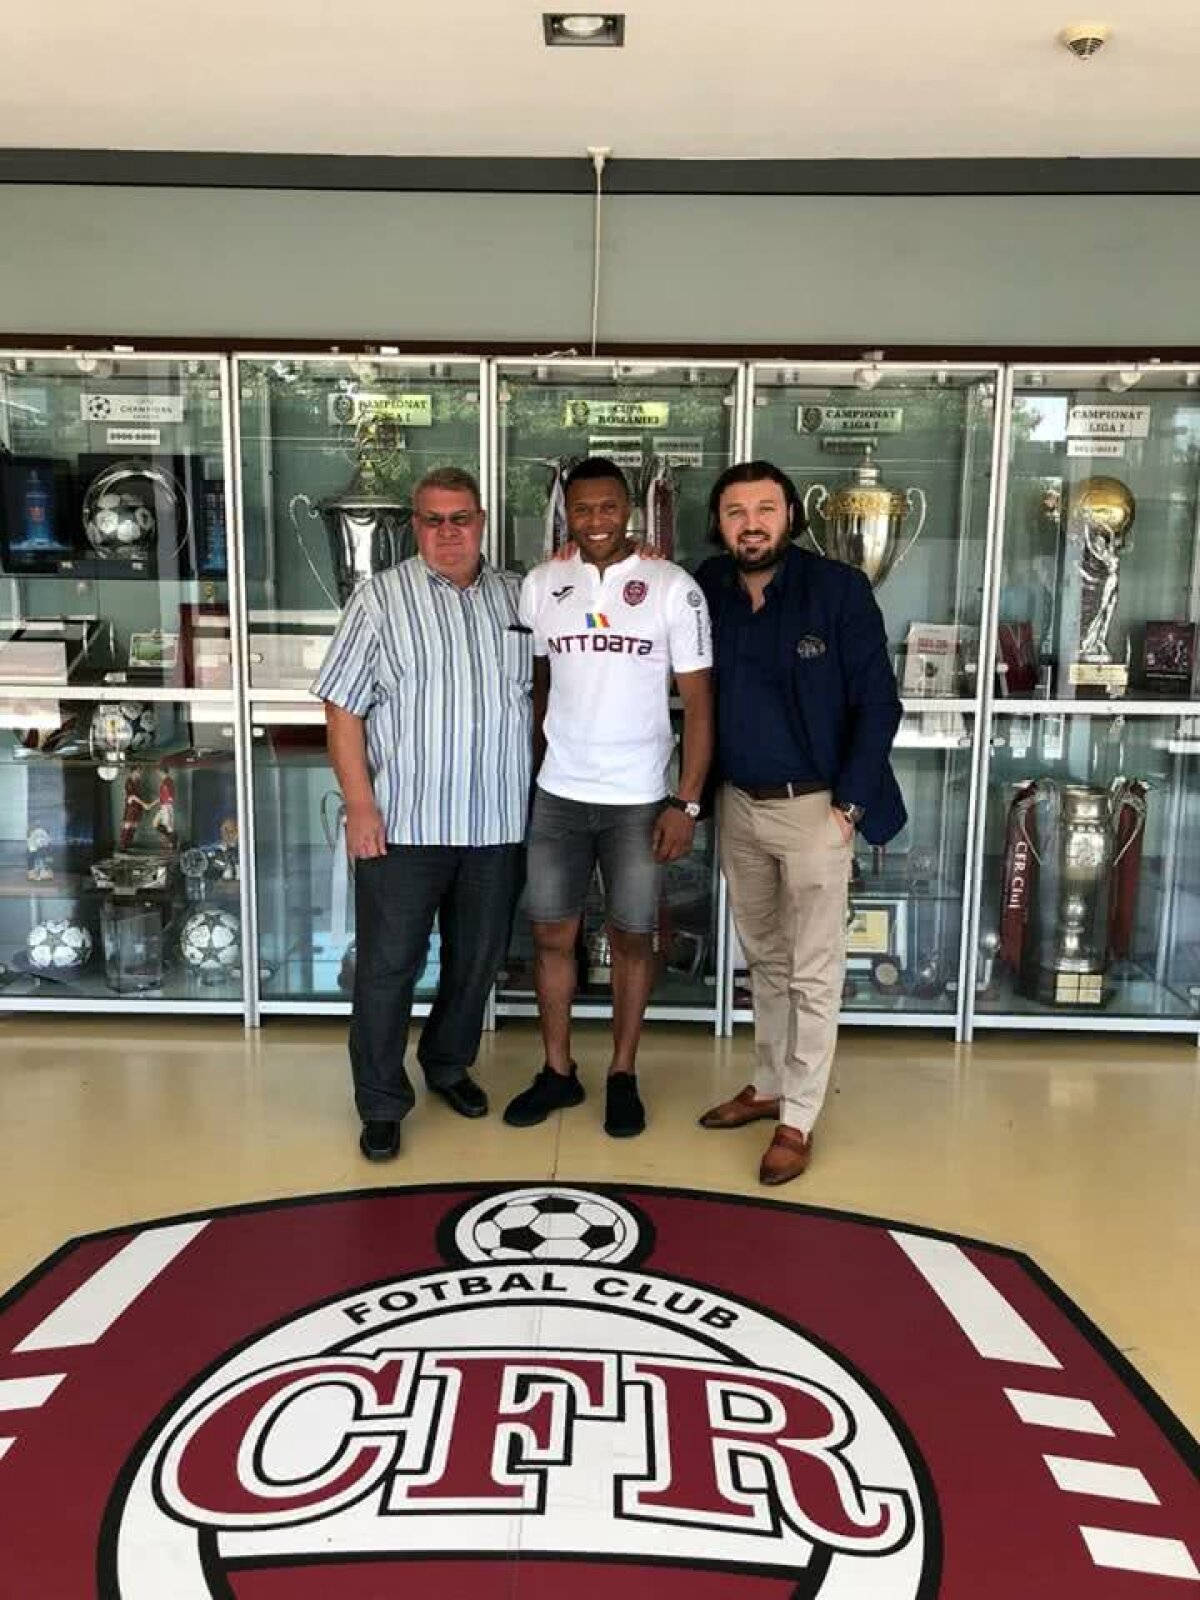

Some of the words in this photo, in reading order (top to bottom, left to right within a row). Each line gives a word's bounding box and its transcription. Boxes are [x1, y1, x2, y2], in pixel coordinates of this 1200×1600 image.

[826, 409, 896, 420] CAMPIONAT
[1072, 410, 1145, 421] CAMPIONAT
[1090, 423, 1116, 433] LIGA
[547, 634, 590, 655] NTT
[1014, 842, 1027, 871] CFR
[343, 1272, 568, 1326] FOTBAL
[592, 1276, 741, 1330] CLUB
[154, 1348, 912, 1556] CFR
